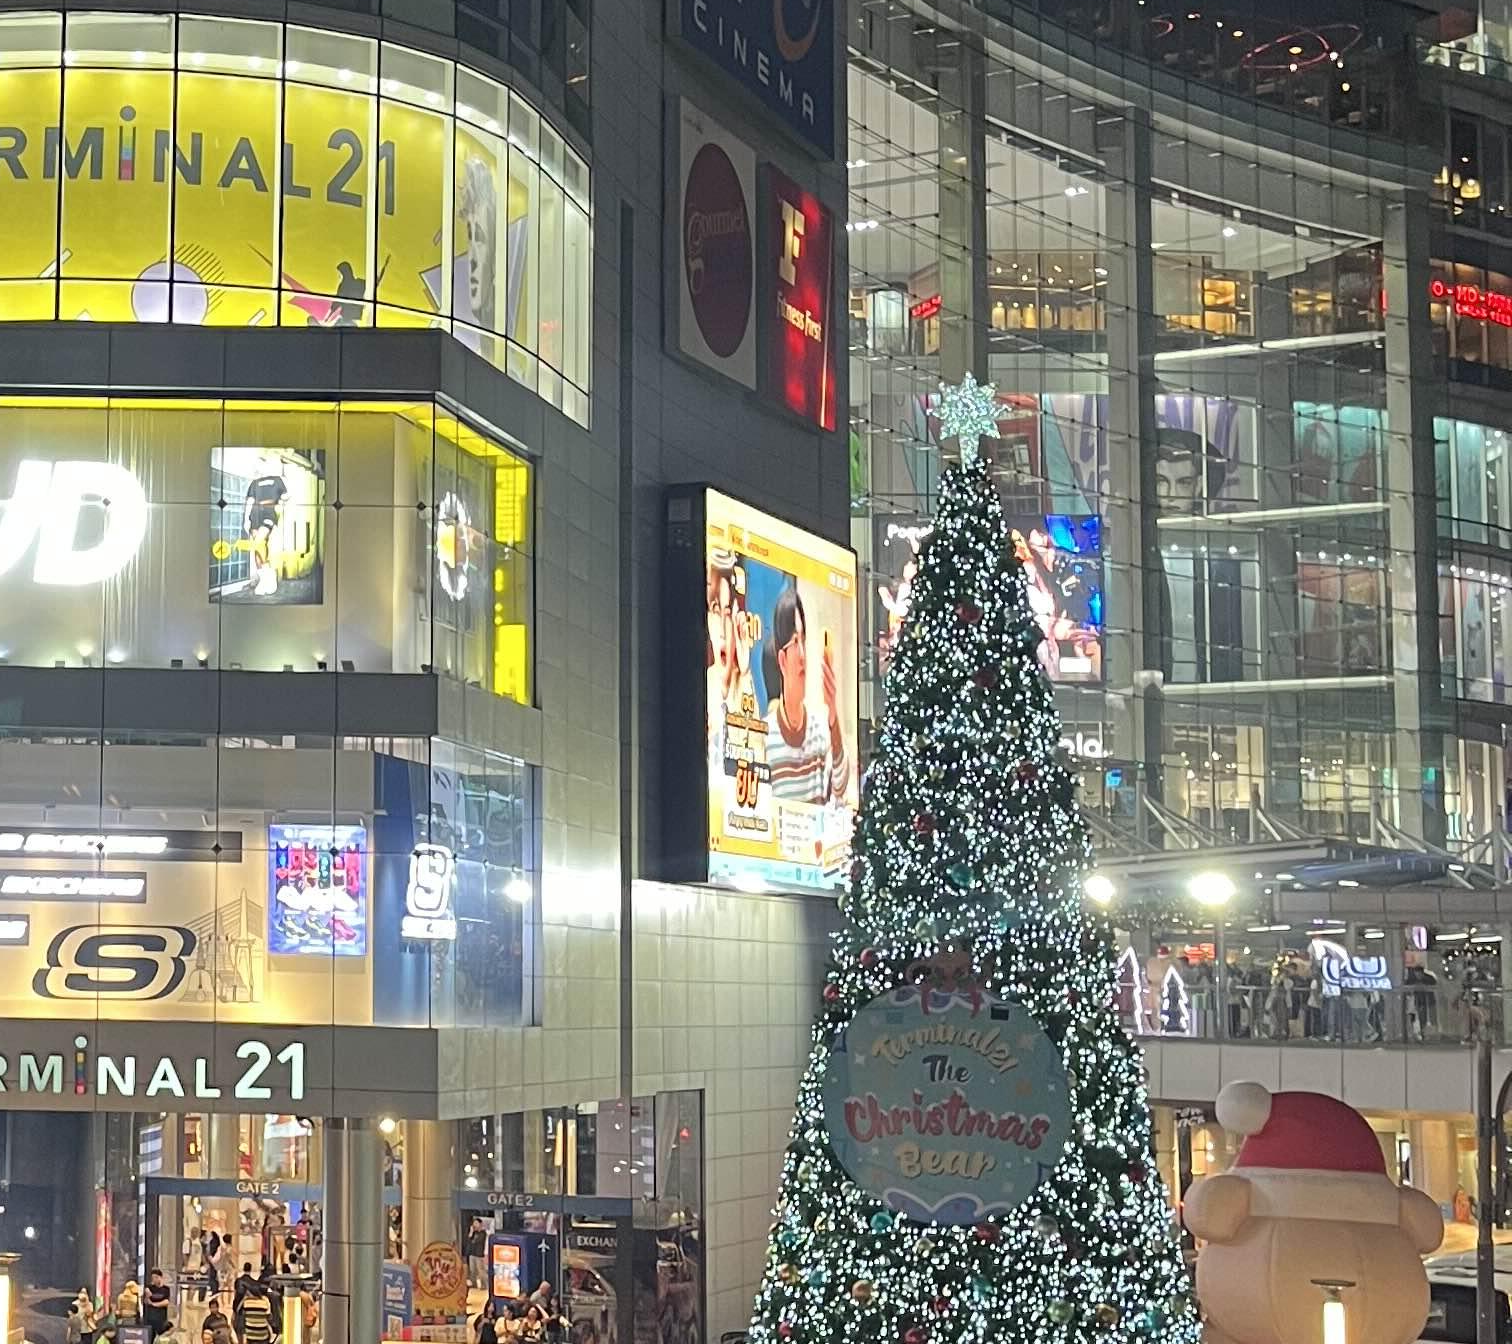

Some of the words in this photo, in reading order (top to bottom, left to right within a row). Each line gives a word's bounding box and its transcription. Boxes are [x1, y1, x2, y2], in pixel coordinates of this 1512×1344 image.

[922, 1054, 973, 1084] The
[843, 1088, 1050, 1149] Christmas
[895, 1144, 999, 1179] Bear
[236, 1181, 268, 1194] GATE
[271, 1183, 281, 1195] 2
[487, 1193, 524, 1206] GATE
[525, 1195, 534, 1207] 2
[576, 1235, 617, 1248] EXCHAN
